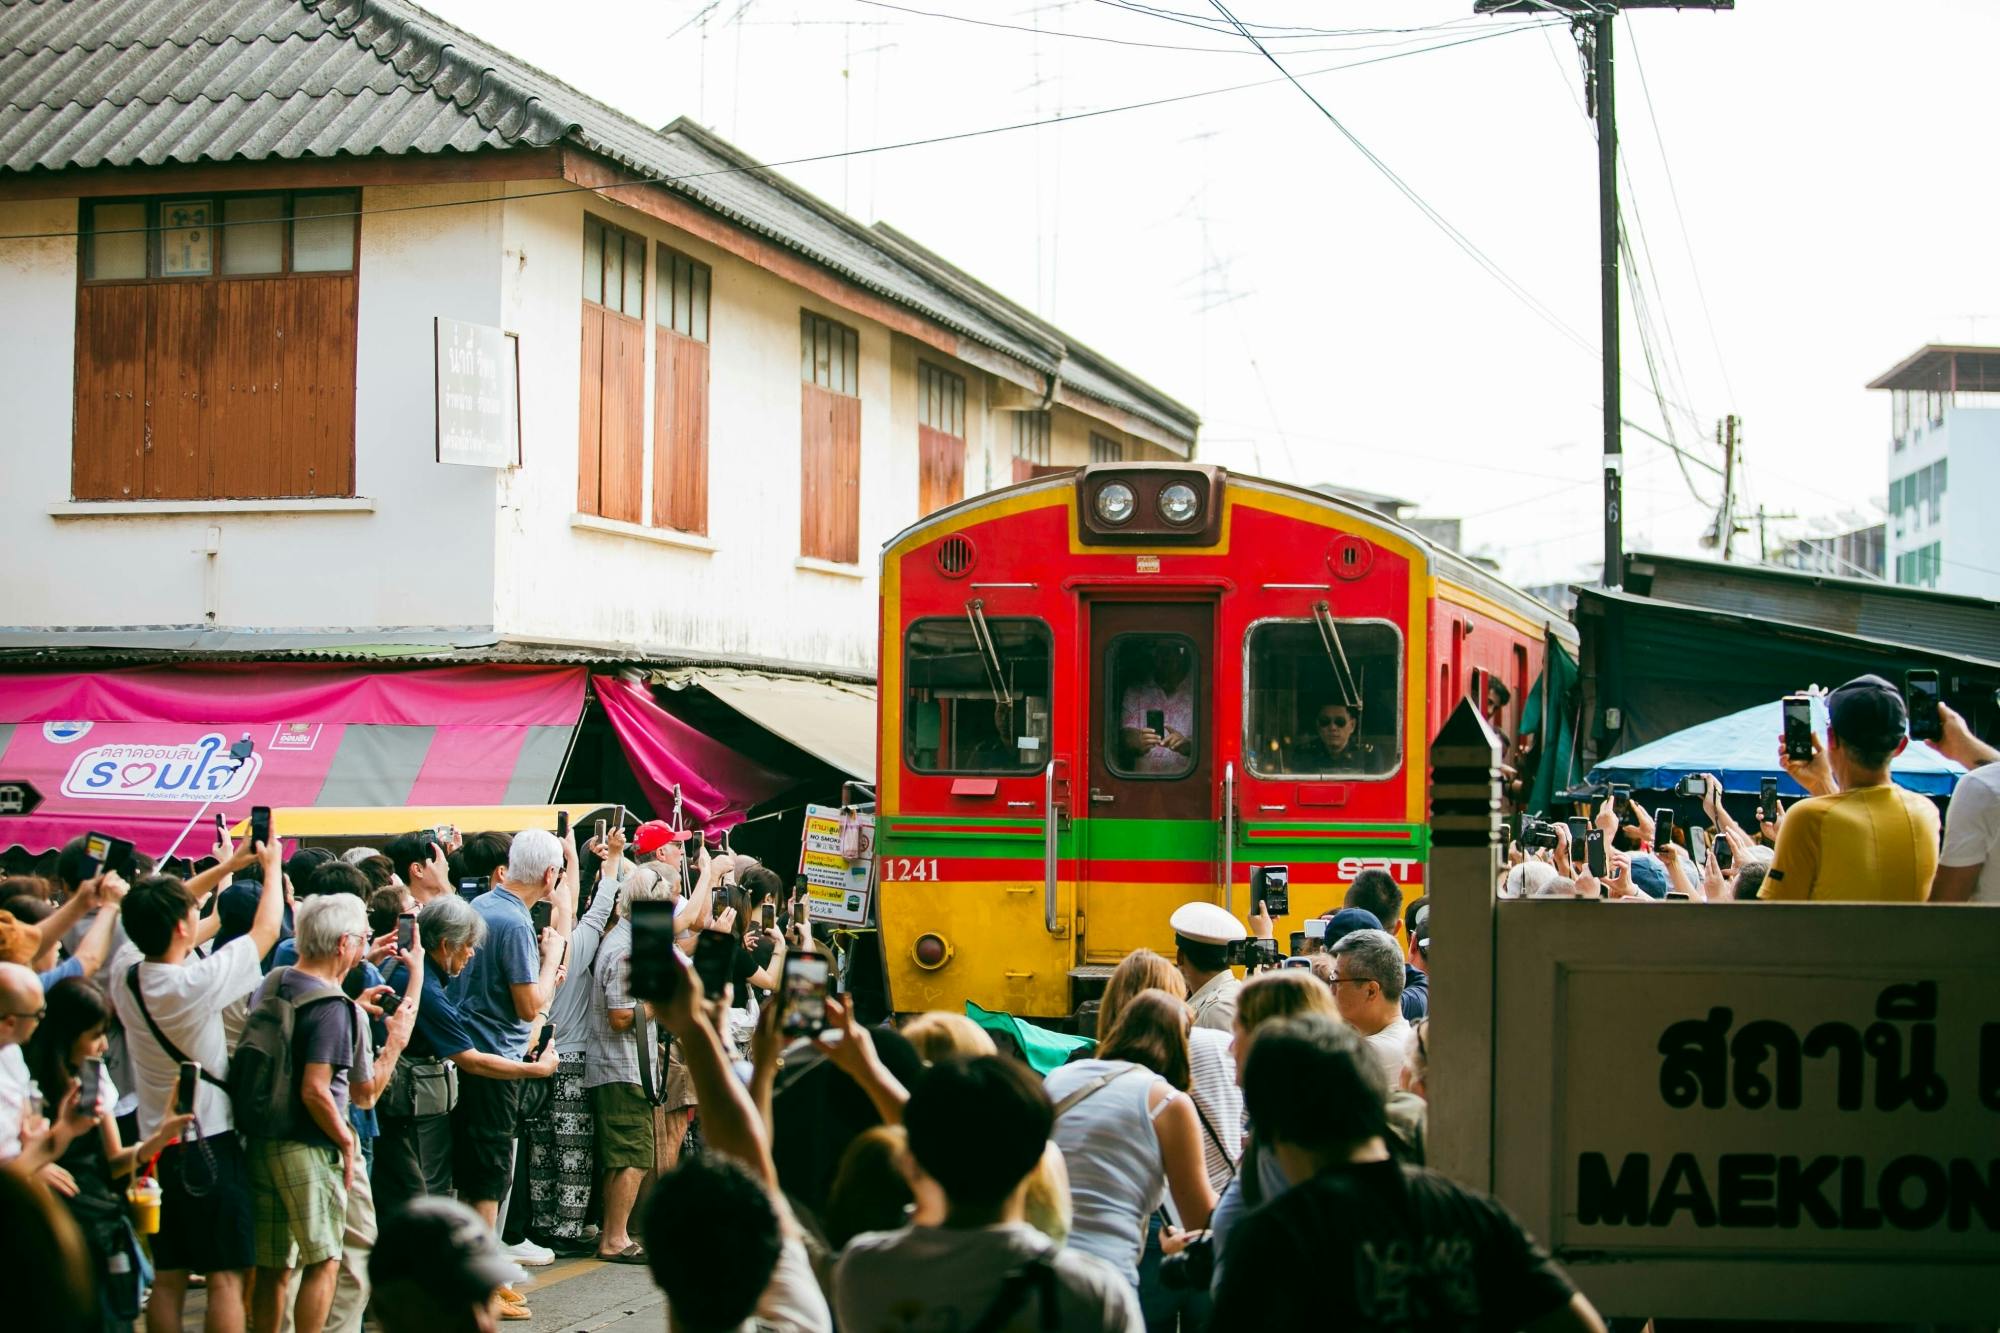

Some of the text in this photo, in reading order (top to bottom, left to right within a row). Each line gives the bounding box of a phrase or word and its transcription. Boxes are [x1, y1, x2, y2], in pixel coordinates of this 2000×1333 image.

[100, 747, 200, 761] ตลาดออมสิน
[884, 859, 940, 882] 1241
[1337, 857, 1418, 881] SRT
[1657, 980, 1949, 1112] สถานี
